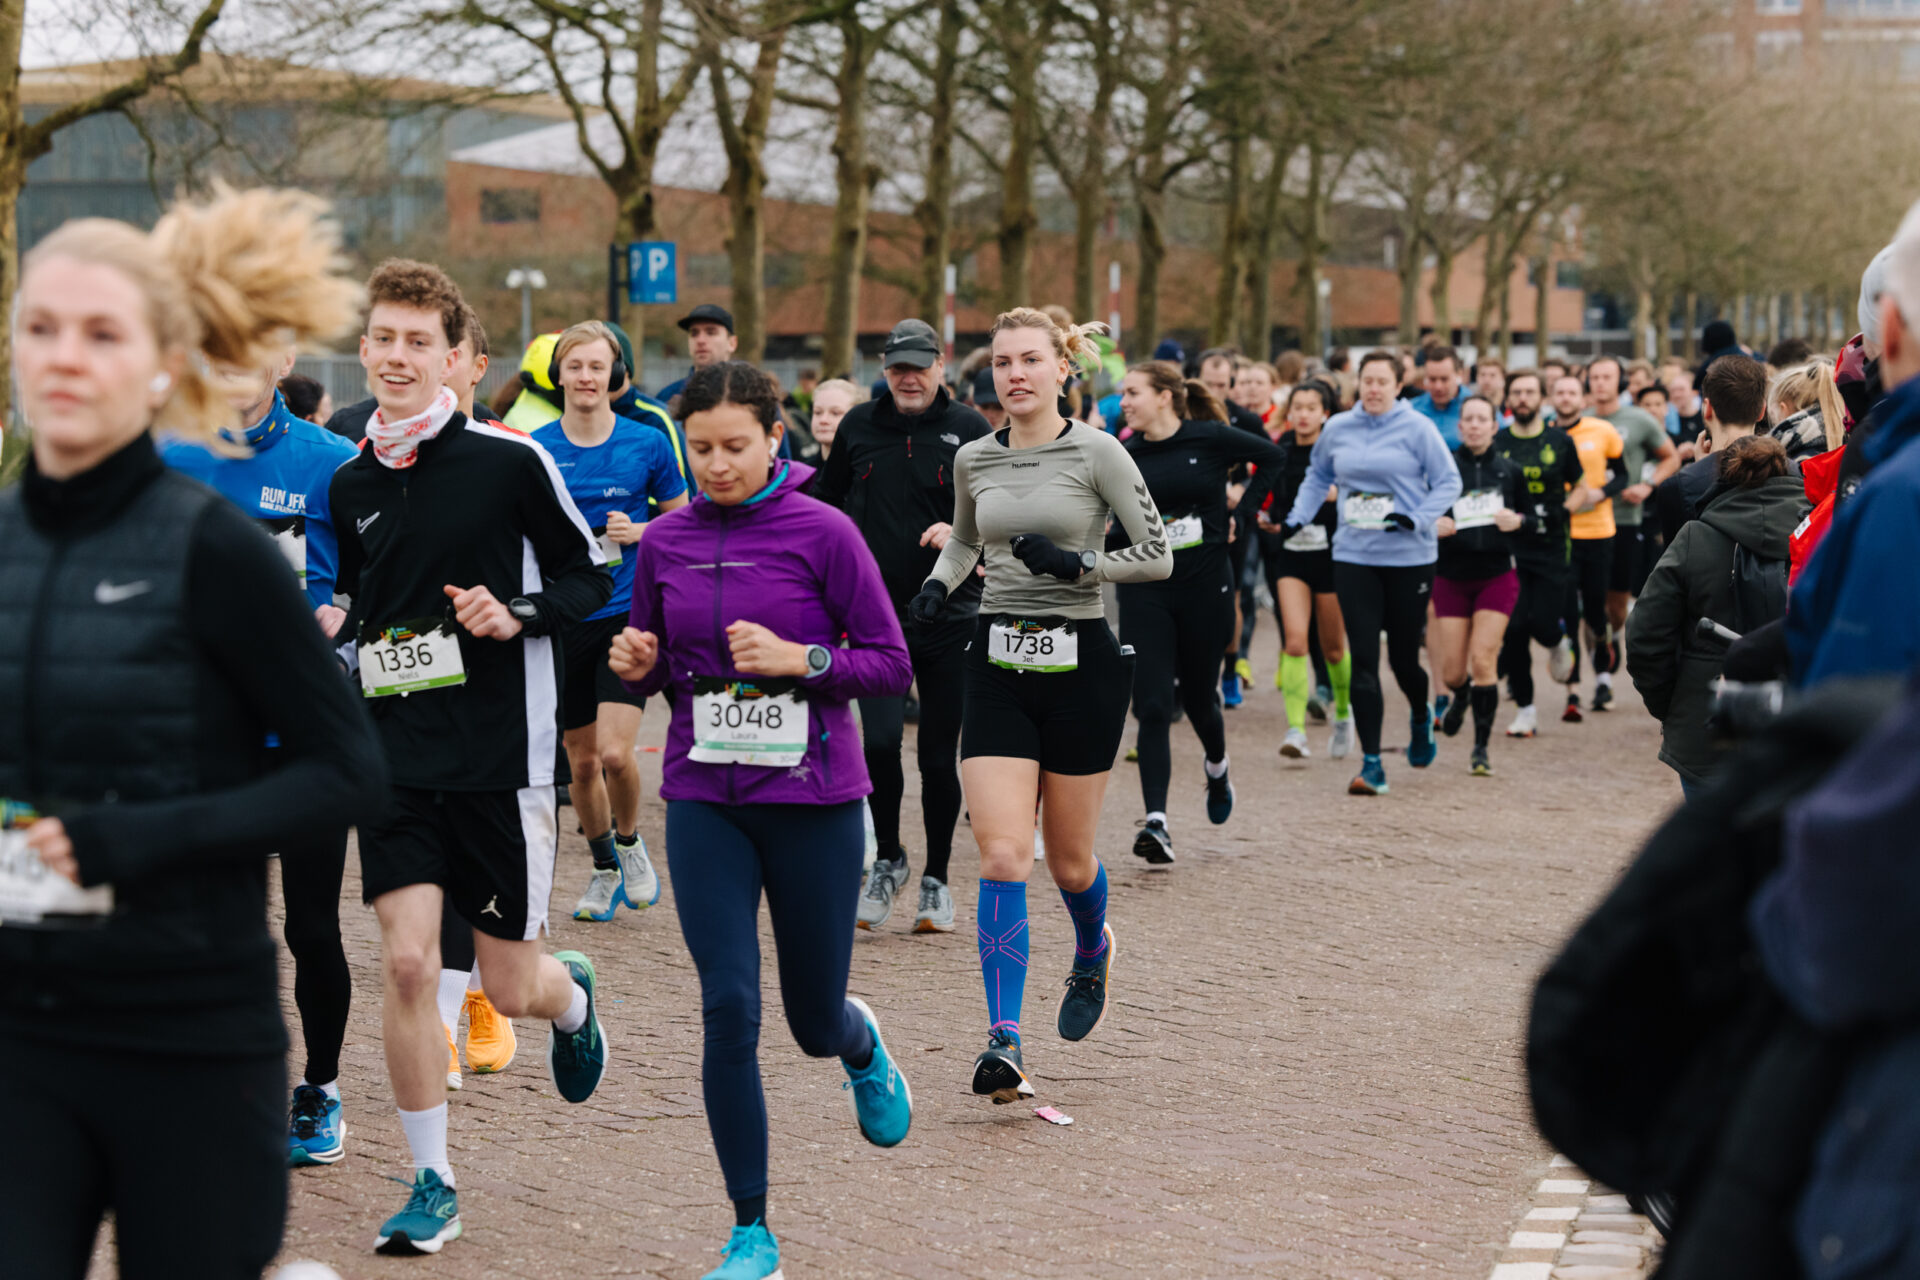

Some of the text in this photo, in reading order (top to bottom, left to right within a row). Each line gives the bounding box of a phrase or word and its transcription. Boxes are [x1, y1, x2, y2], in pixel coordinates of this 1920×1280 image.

[649, 248, 669, 281] P
[1012, 461, 1040, 469] hummel
[261, 486, 286, 505] RUN
[287, 493, 307, 510] JFK
[1166, 523, 1187, 538] 32
[1004, 633, 1054, 655] 1738
[374, 643, 433, 673] 1336
[710, 703, 782, 729] 3048
[731, 731, 758, 740] Laura
